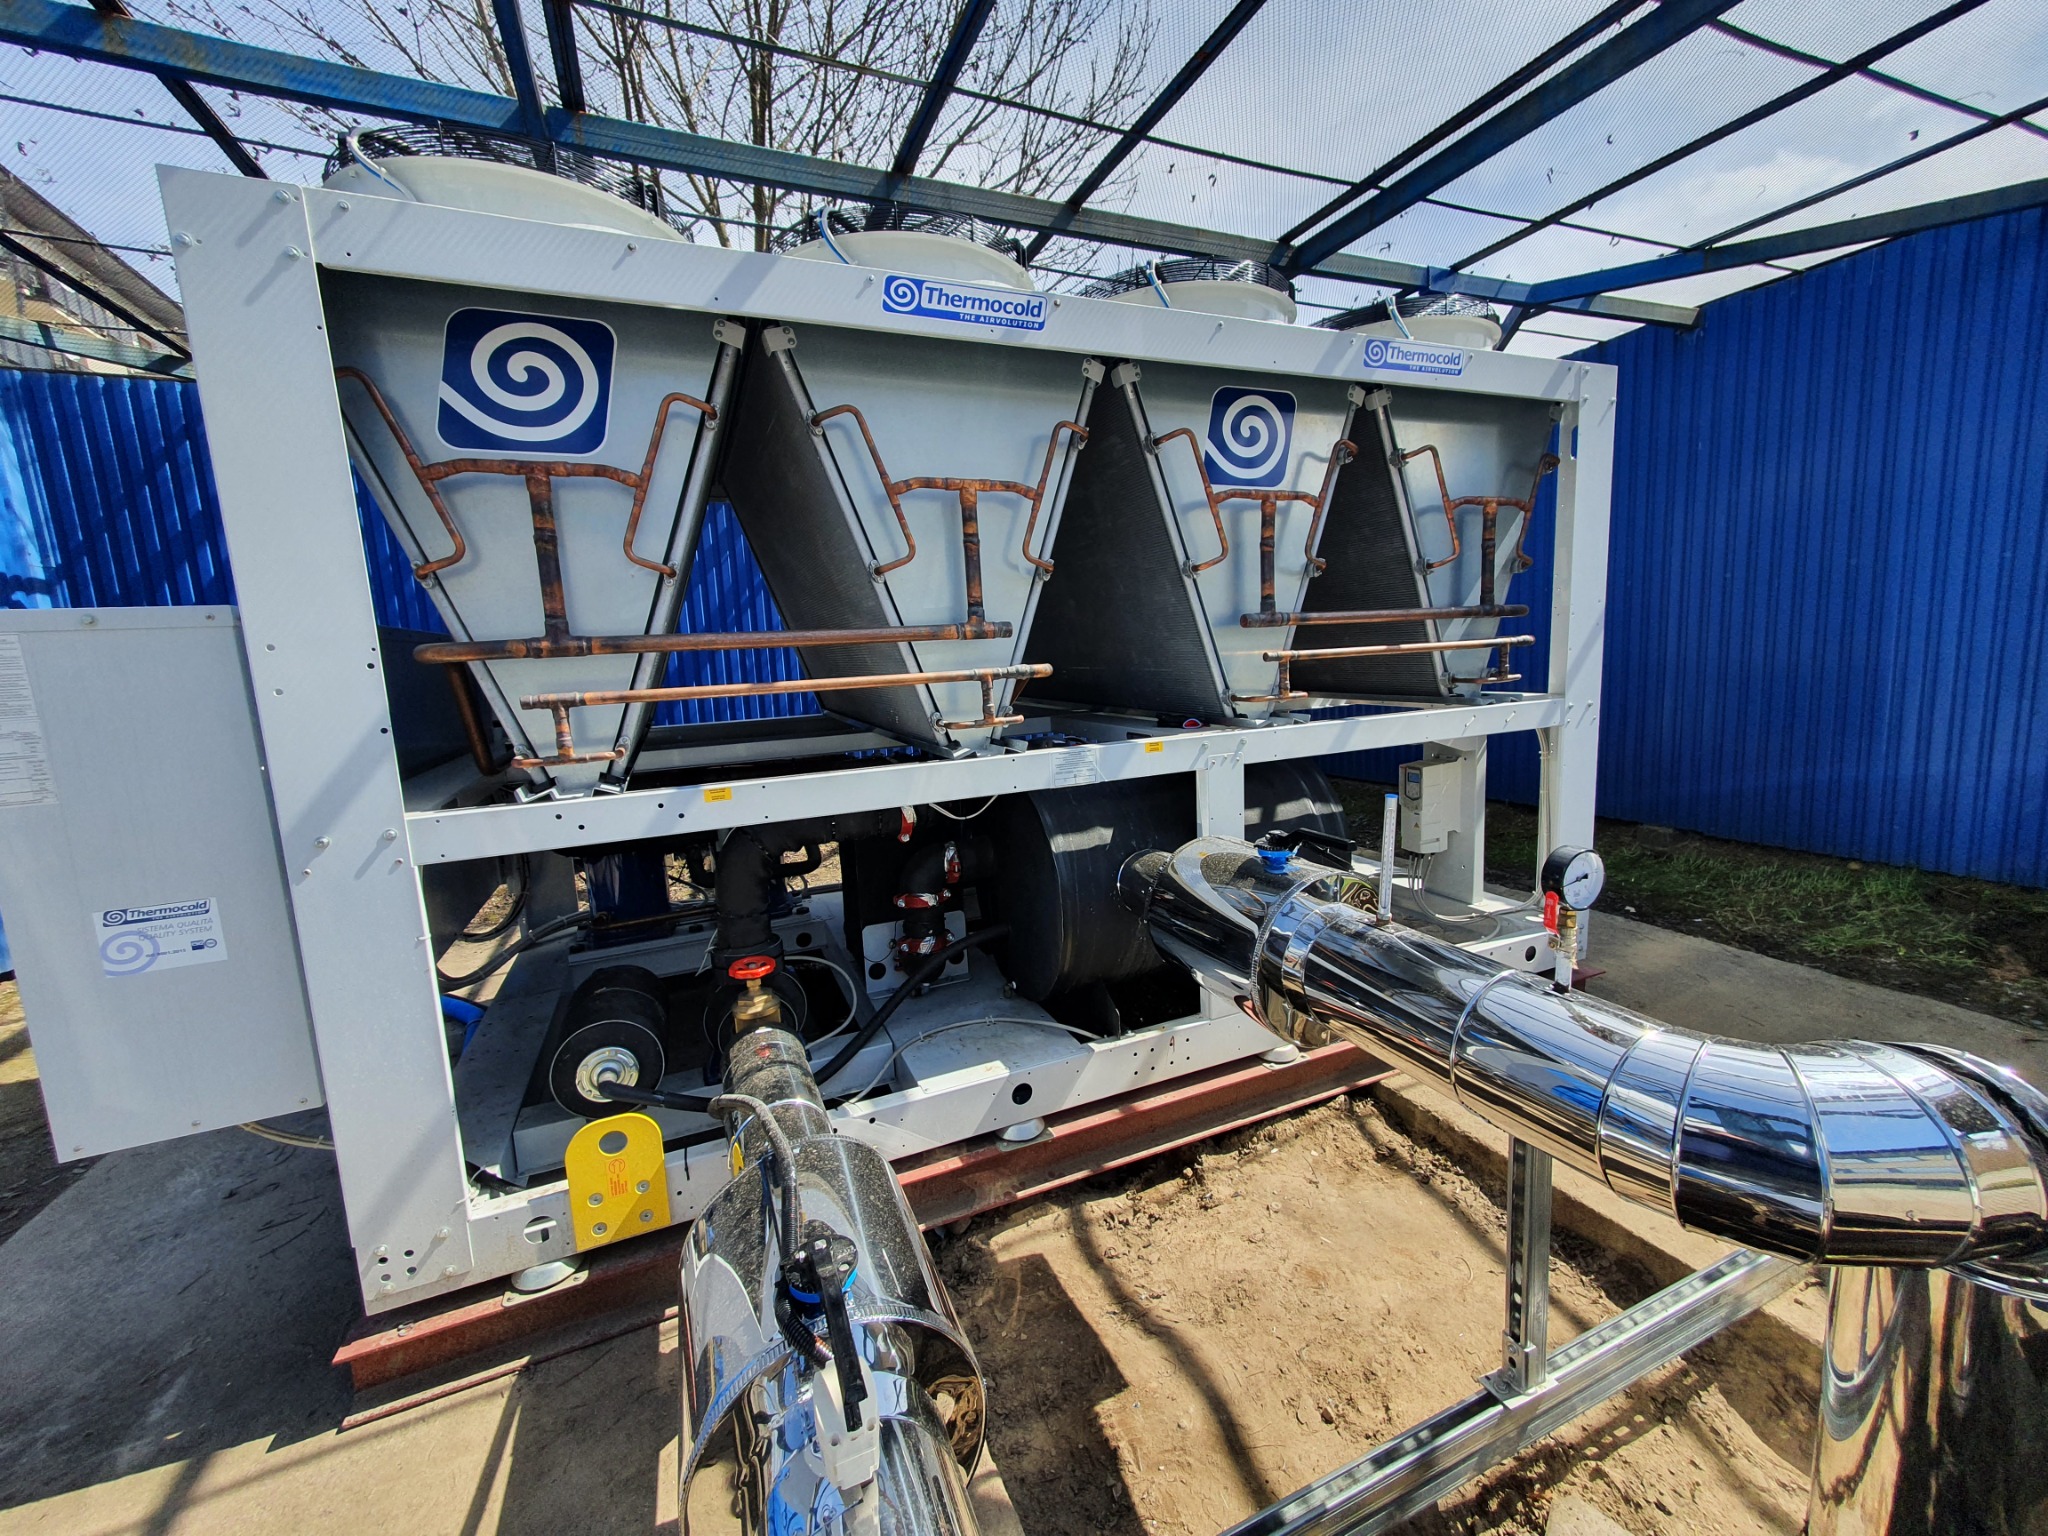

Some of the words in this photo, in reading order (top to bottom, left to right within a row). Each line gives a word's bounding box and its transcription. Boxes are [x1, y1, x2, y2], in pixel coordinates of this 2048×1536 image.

[925, 287, 1042, 318] Thermocold
[959, 313, 975, 321] THE
[979, 315, 1040, 329] AIRVOLUTION
[1389, 346, 1461, 366] Thermocold
[128, 901, 207, 918] Thermocold
[137, 923, 174, 933] SISTEMA
[138, 930, 176, 941] QUALITY
[178, 925, 213, 935] SYSTEM
